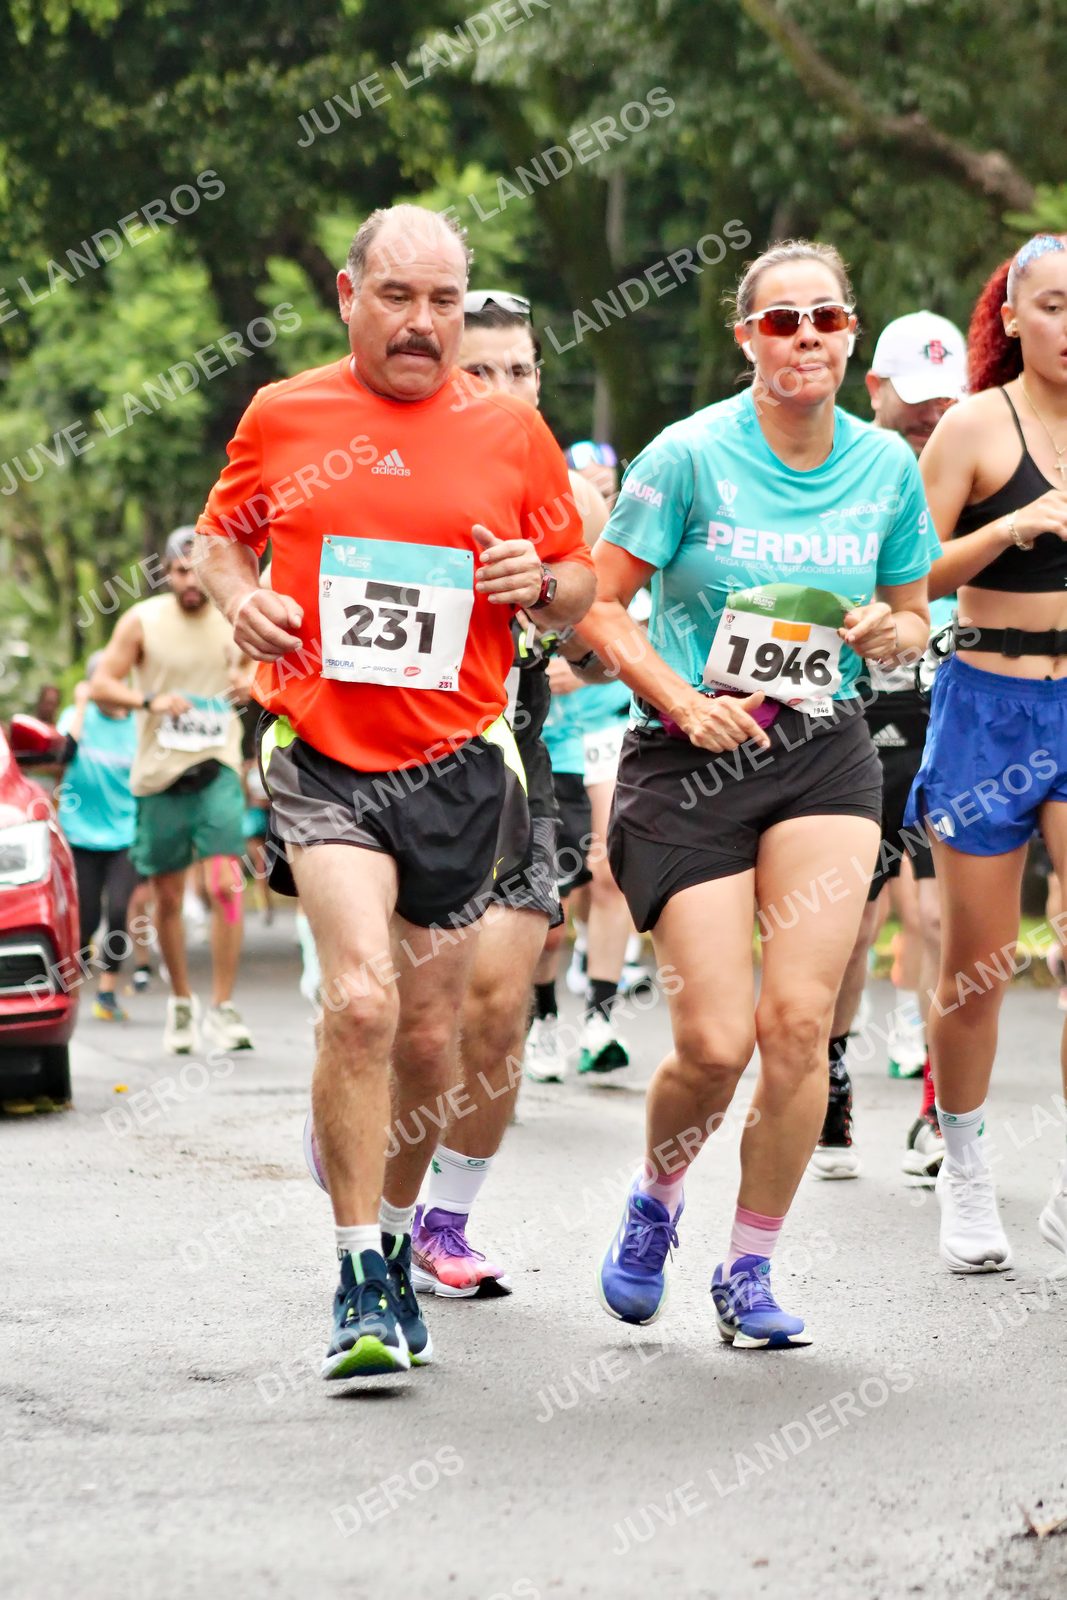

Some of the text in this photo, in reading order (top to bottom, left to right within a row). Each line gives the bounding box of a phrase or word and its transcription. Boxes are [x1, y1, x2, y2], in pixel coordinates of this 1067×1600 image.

[371, 465, 411, 477] adidas
[706, 520, 878, 566] PERDURA
[342, 604, 436, 654] 231
[727, 635, 833, 686] 1946
[438, 681, 453, 689] 231
